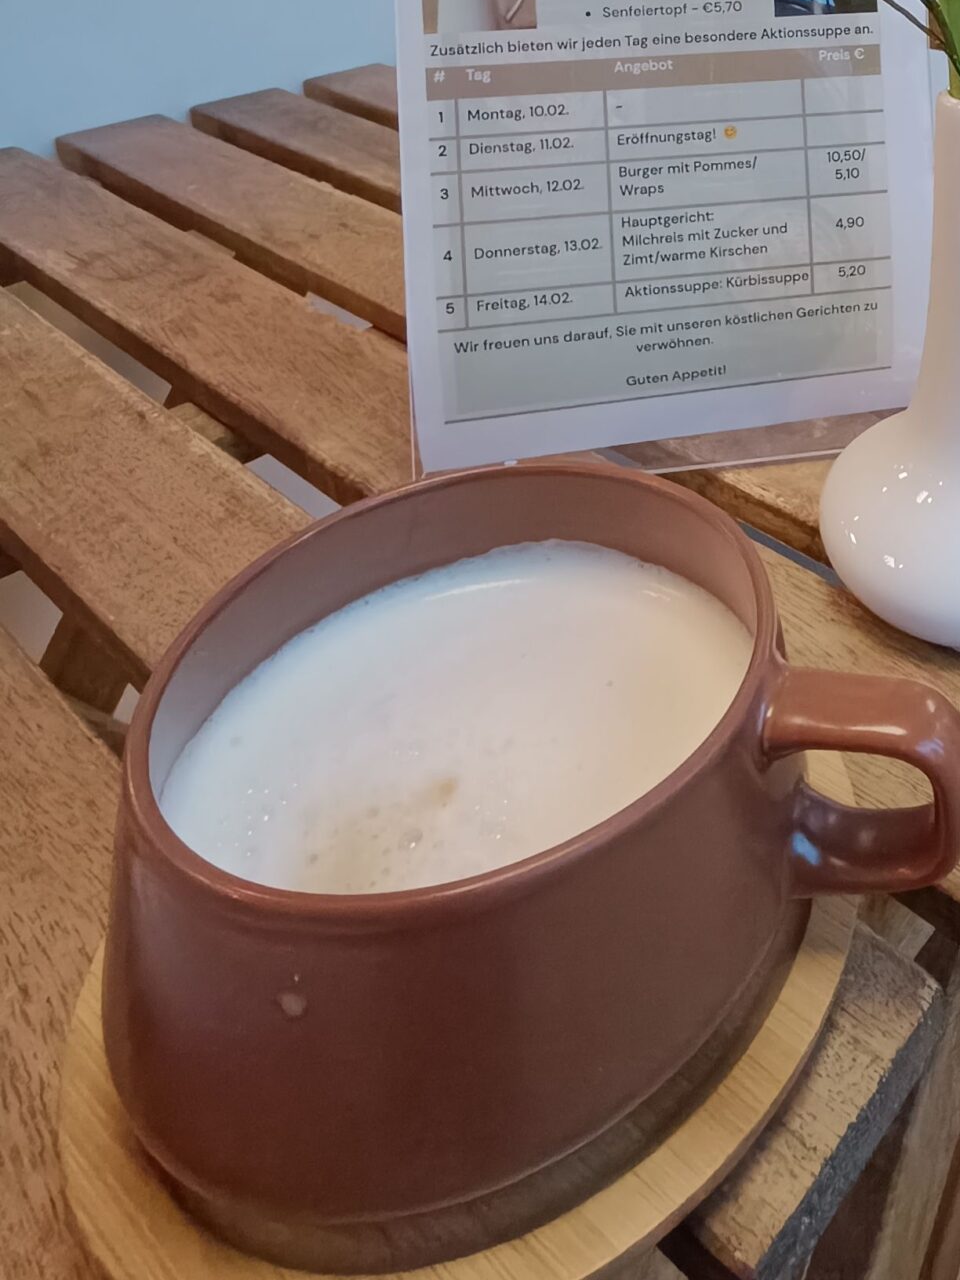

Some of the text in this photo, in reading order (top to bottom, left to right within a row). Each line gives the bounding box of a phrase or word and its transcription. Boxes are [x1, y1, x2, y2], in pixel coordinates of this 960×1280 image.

[602, 3, 689, 20] Senfeiertopf
[702, 0, 742, 15] €5,70
[430, 24, 874, 57] Zusätzlich bieten wir jeden Tag eine besondere Aktionssuppe an.
[432, 48, 865, 84] # Tag Angebot Preis €
[438, 111, 444, 123] 1
[467, 103, 570, 122] Montag, 10.02.
[469, 136, 575, 156] Dienstag, 11.02.
[616, 128, 717, 147] Eröffnungstag!
[438, 144, 448, 157] 2
[826, 147, 867, 164] 10,50/
[618, 156, 758, 181] Burger mit Pommes/
[834, 167, 861, 182] 5,10
[439, 188, 450, 200] 3
[470, 181, 543, 199] Mittwoch,
[619, 182, 665, 198] Wraps
[621, 210, 715, 230] Hauptgericht:
[835, 216, 865, 231] 4,90
[622, 222, 788, 248] Milchreis mit Zucker und
[443, 249, 453, 262] 4
[473, 242, 562, 260] Donnerstag,
[622, 242, 769, 267] Zimt/warme Kirschen
[838, 264, 867, 280] 5,20
[624, 270, 810, 299] Aktionssuppe: Kürbissuppe
[445, 302, 455, 315] 5
[476, 291, 573, 315] Freitag, 14.02.
[453, 300, 879, 354] Wir freuen uns darauf, Sie mit unseren köstlichen Gerichten zu
[636, 335, 715, 354] verwöhnen.
[625, 364, 727, 387] Guten Appetit!
